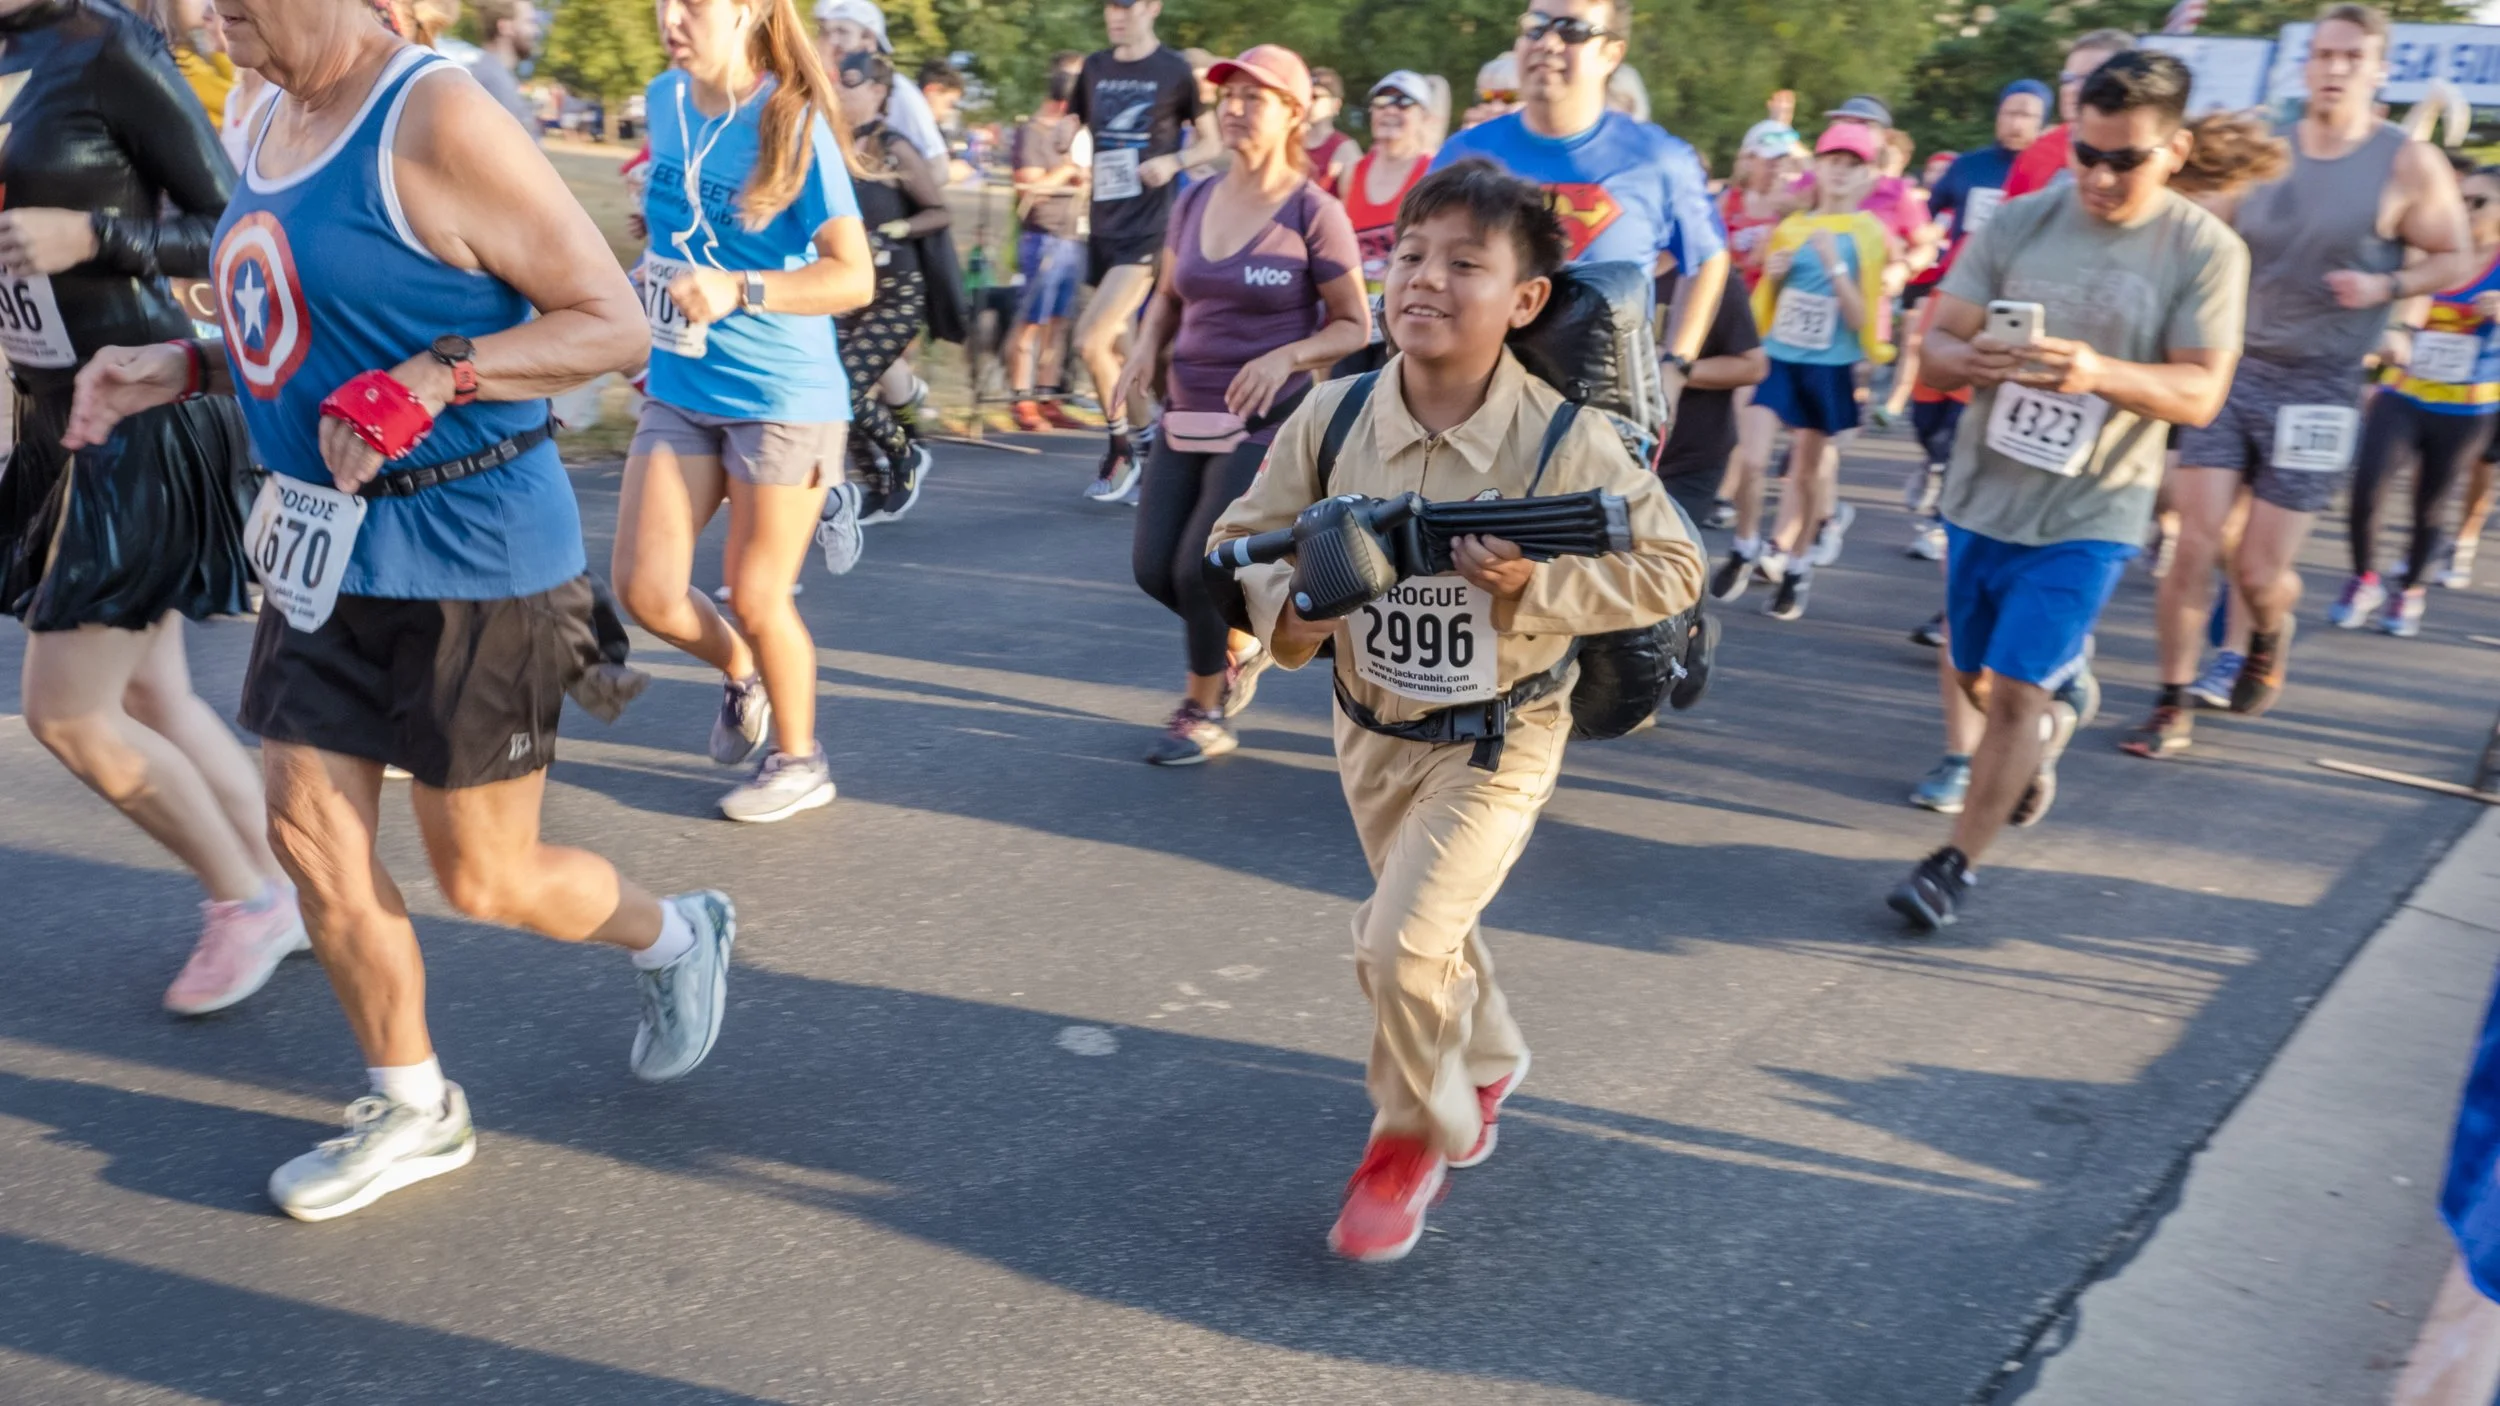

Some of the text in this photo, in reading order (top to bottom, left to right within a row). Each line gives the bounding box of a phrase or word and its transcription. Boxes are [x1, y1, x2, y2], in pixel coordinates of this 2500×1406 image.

[700, 180, 740, 204] EET
[0, 281, 42, 331] 96
[649, 281, 691, 327] 70
[2008, 397, 2081, 447] 4323
[1387, 586, 1468, 607] ROGUE
[1362, 604, 1474, 668] 2996
[1367, 666, 1478, 695] www.roguerunning.com
[1371, 660, 1470, 683] www.jackrabbit.com
